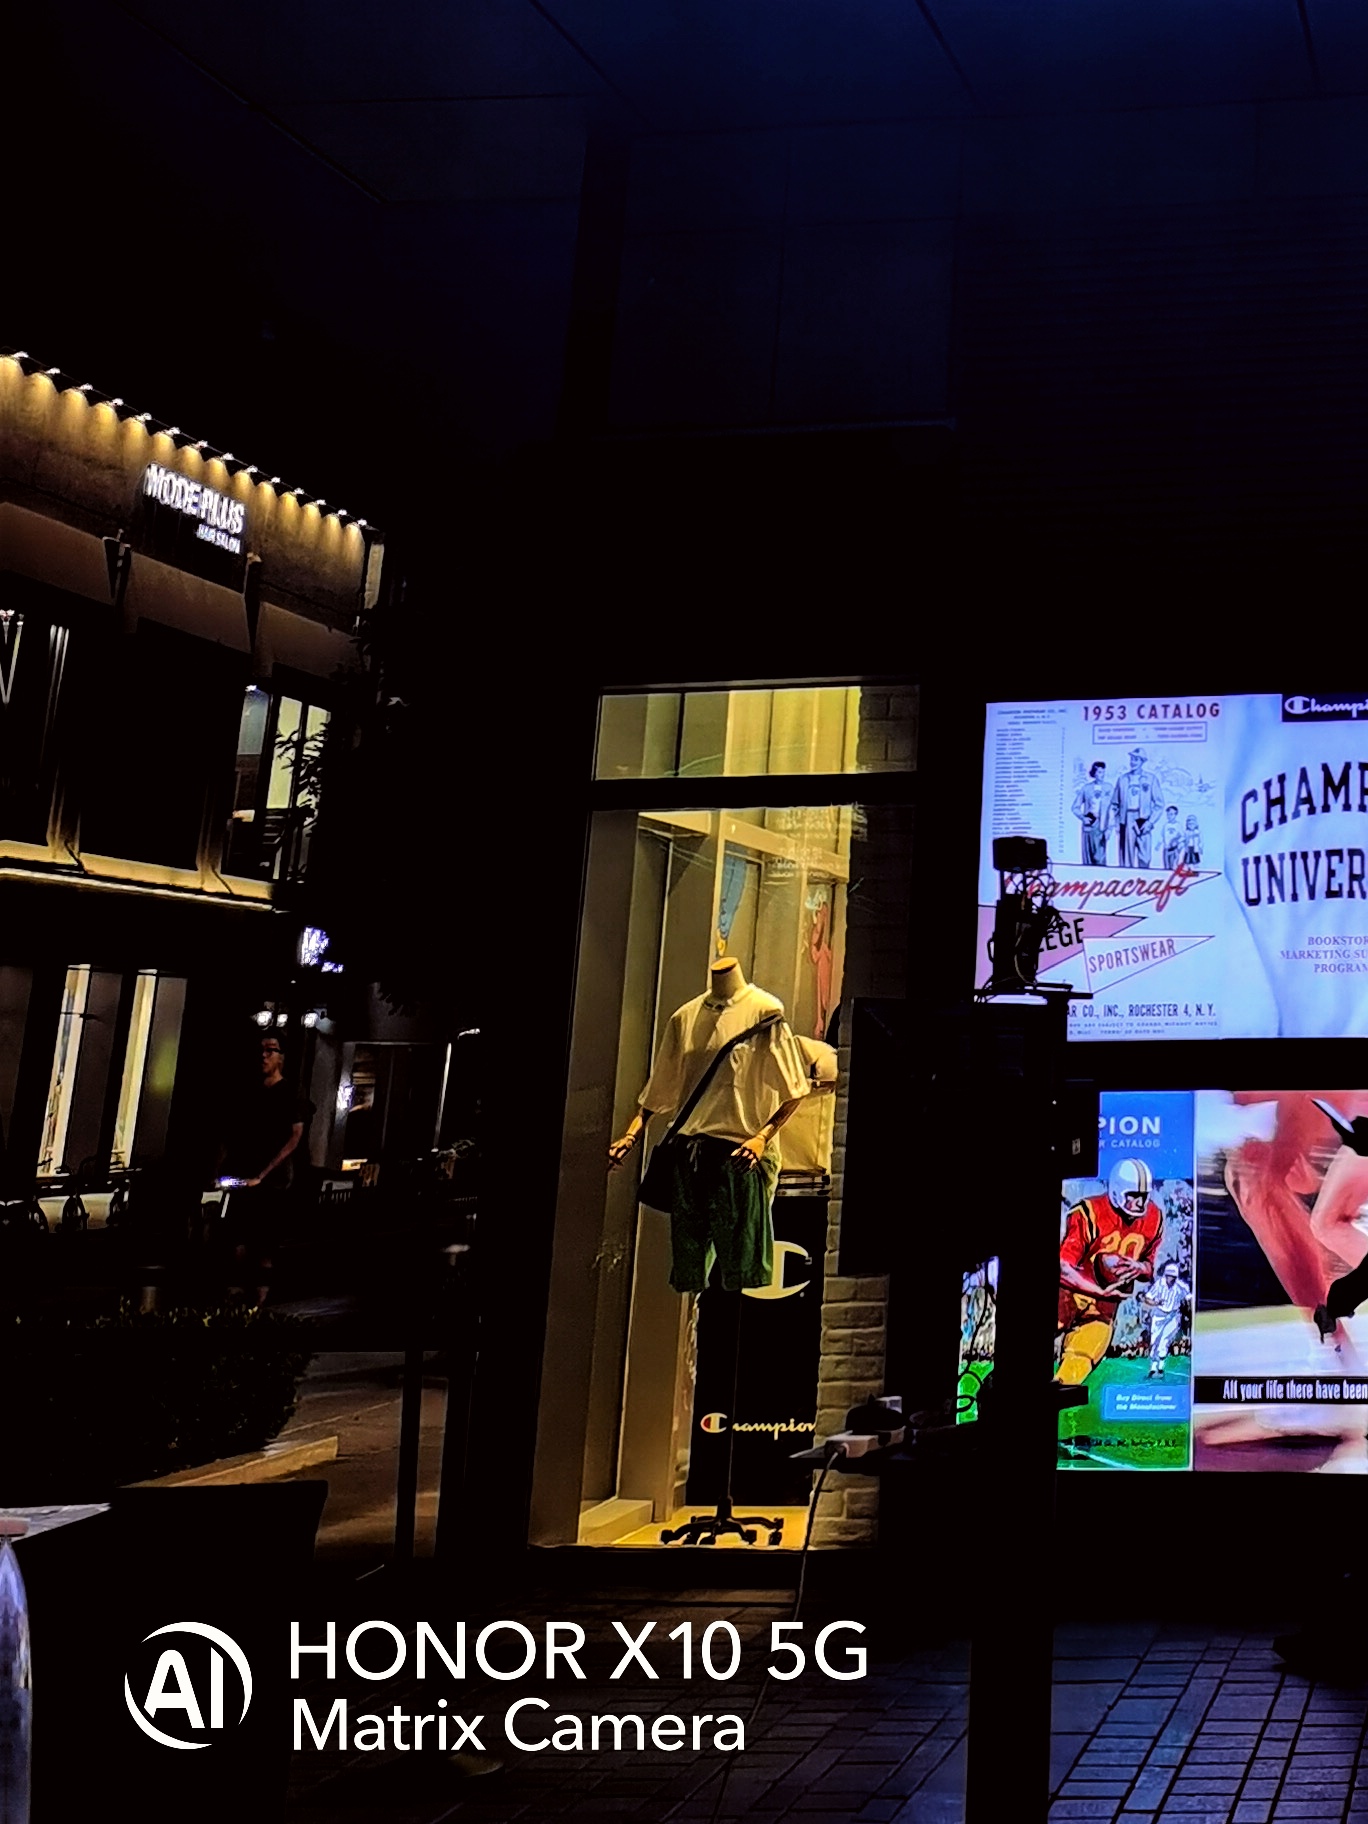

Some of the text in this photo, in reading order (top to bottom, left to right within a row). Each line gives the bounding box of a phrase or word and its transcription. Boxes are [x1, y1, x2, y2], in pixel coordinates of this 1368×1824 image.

[1083, 705, 1128, 721] 1953
[1136, 702, 1221, 720] CATALOG
[1088, 938, 1177, 975] SPORTSWEAR
[1280, 949, 1352, 960] MARKETING
[1128, 1003, 1179, 1018] ROCHESTER
[1110, 1138, 1161, 1148] CATALOG
[1115, 1393, 1130, 1403] Buy
[1222, 1380, 1238, 1399] All
[1240, 1382, 1265, 1402] your
[1265, 1381, 1284, 1399] life
[1286, 1381, 1314, 1400] there
[1315, 1382, 1341, 1400] have
[1342, 1382, 1368, 1400] been
